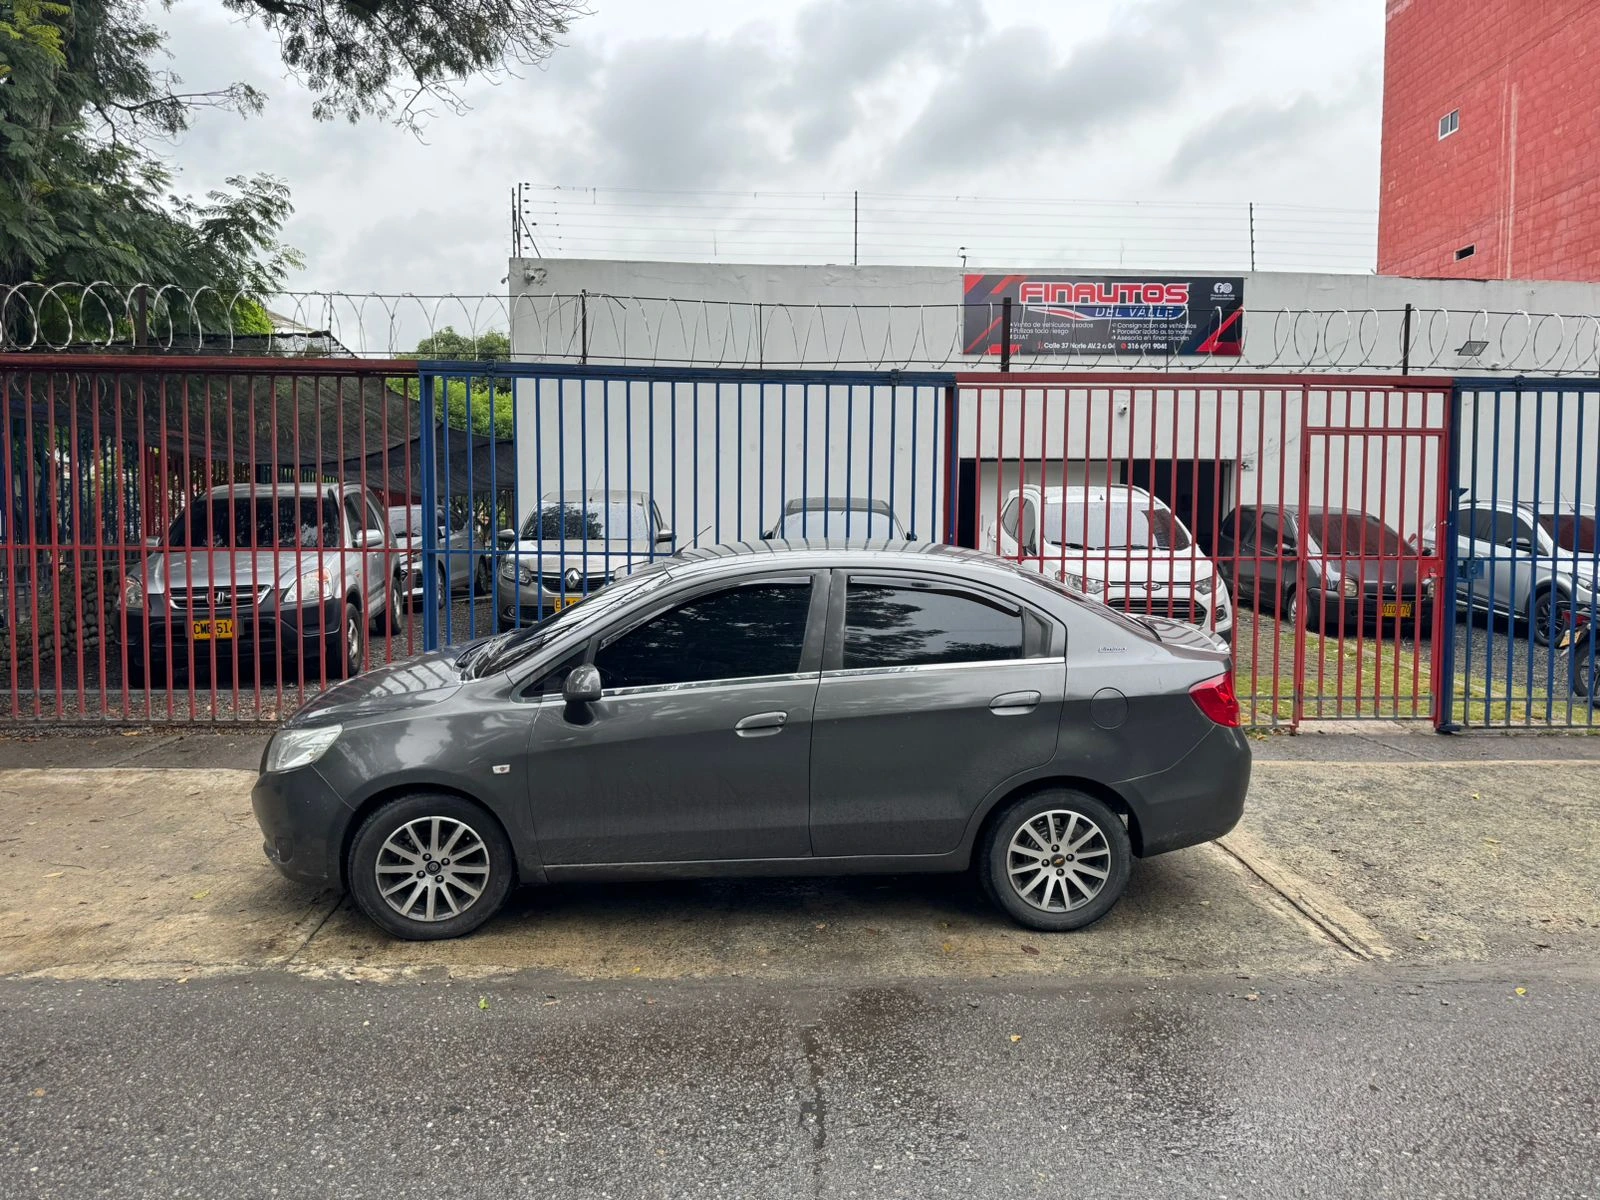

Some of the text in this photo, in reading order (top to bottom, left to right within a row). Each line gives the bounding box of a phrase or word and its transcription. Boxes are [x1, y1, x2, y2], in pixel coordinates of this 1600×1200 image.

[1019, 281, 1189, 305] FINAUTOS
[1094, 305, 1175, 318] DEL VALLE
